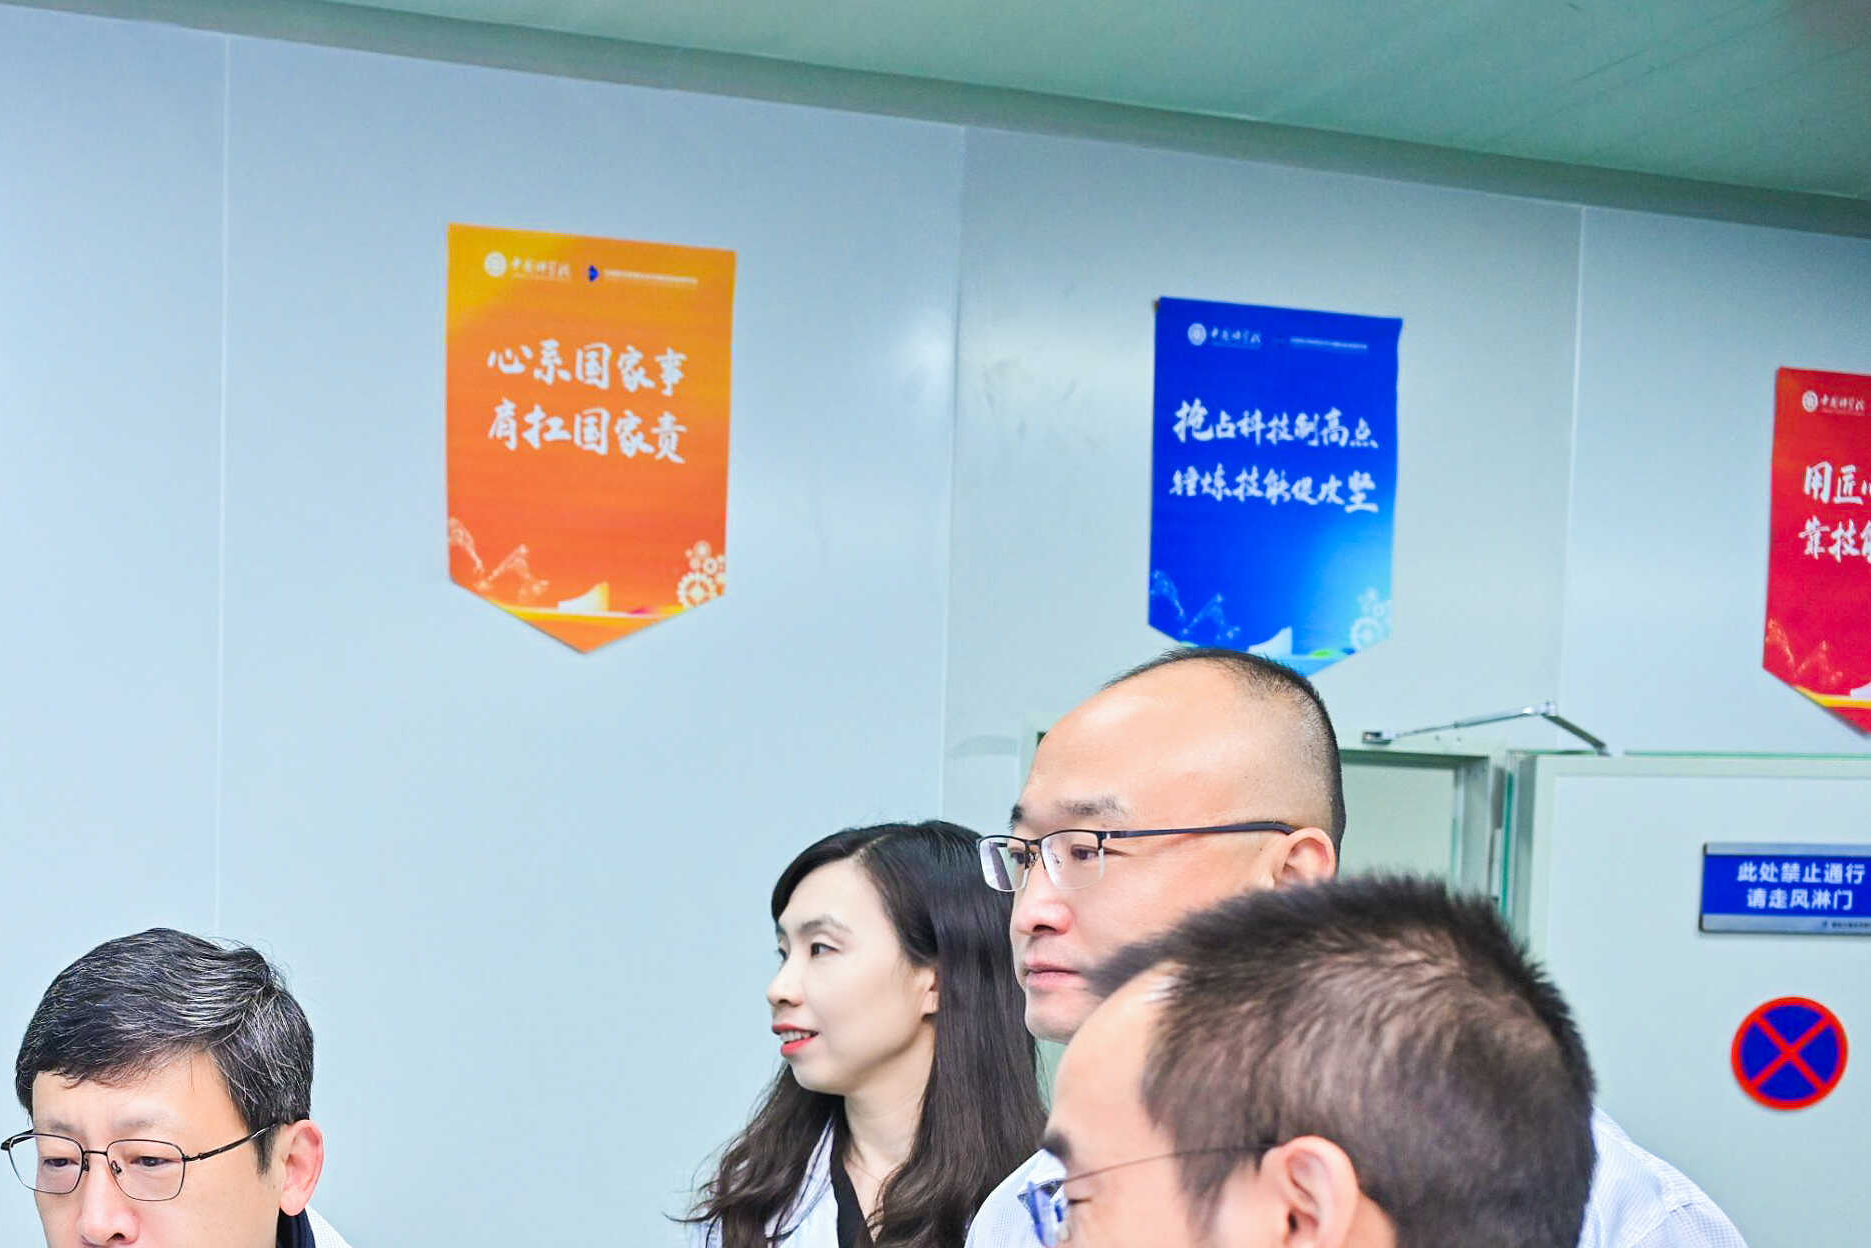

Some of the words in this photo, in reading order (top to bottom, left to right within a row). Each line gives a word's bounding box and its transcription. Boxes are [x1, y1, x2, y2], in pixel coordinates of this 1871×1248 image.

[487, 338, 687, 397] 心系国家事
[488, 397, 687, 464] 肩扛国家责
[1173, 397, 1379, 448] 抢占科技制高点
[1737, 861, 1866, 885] 此处禁止通行
[1746, 888, 1854, 911] 请走风淋门
